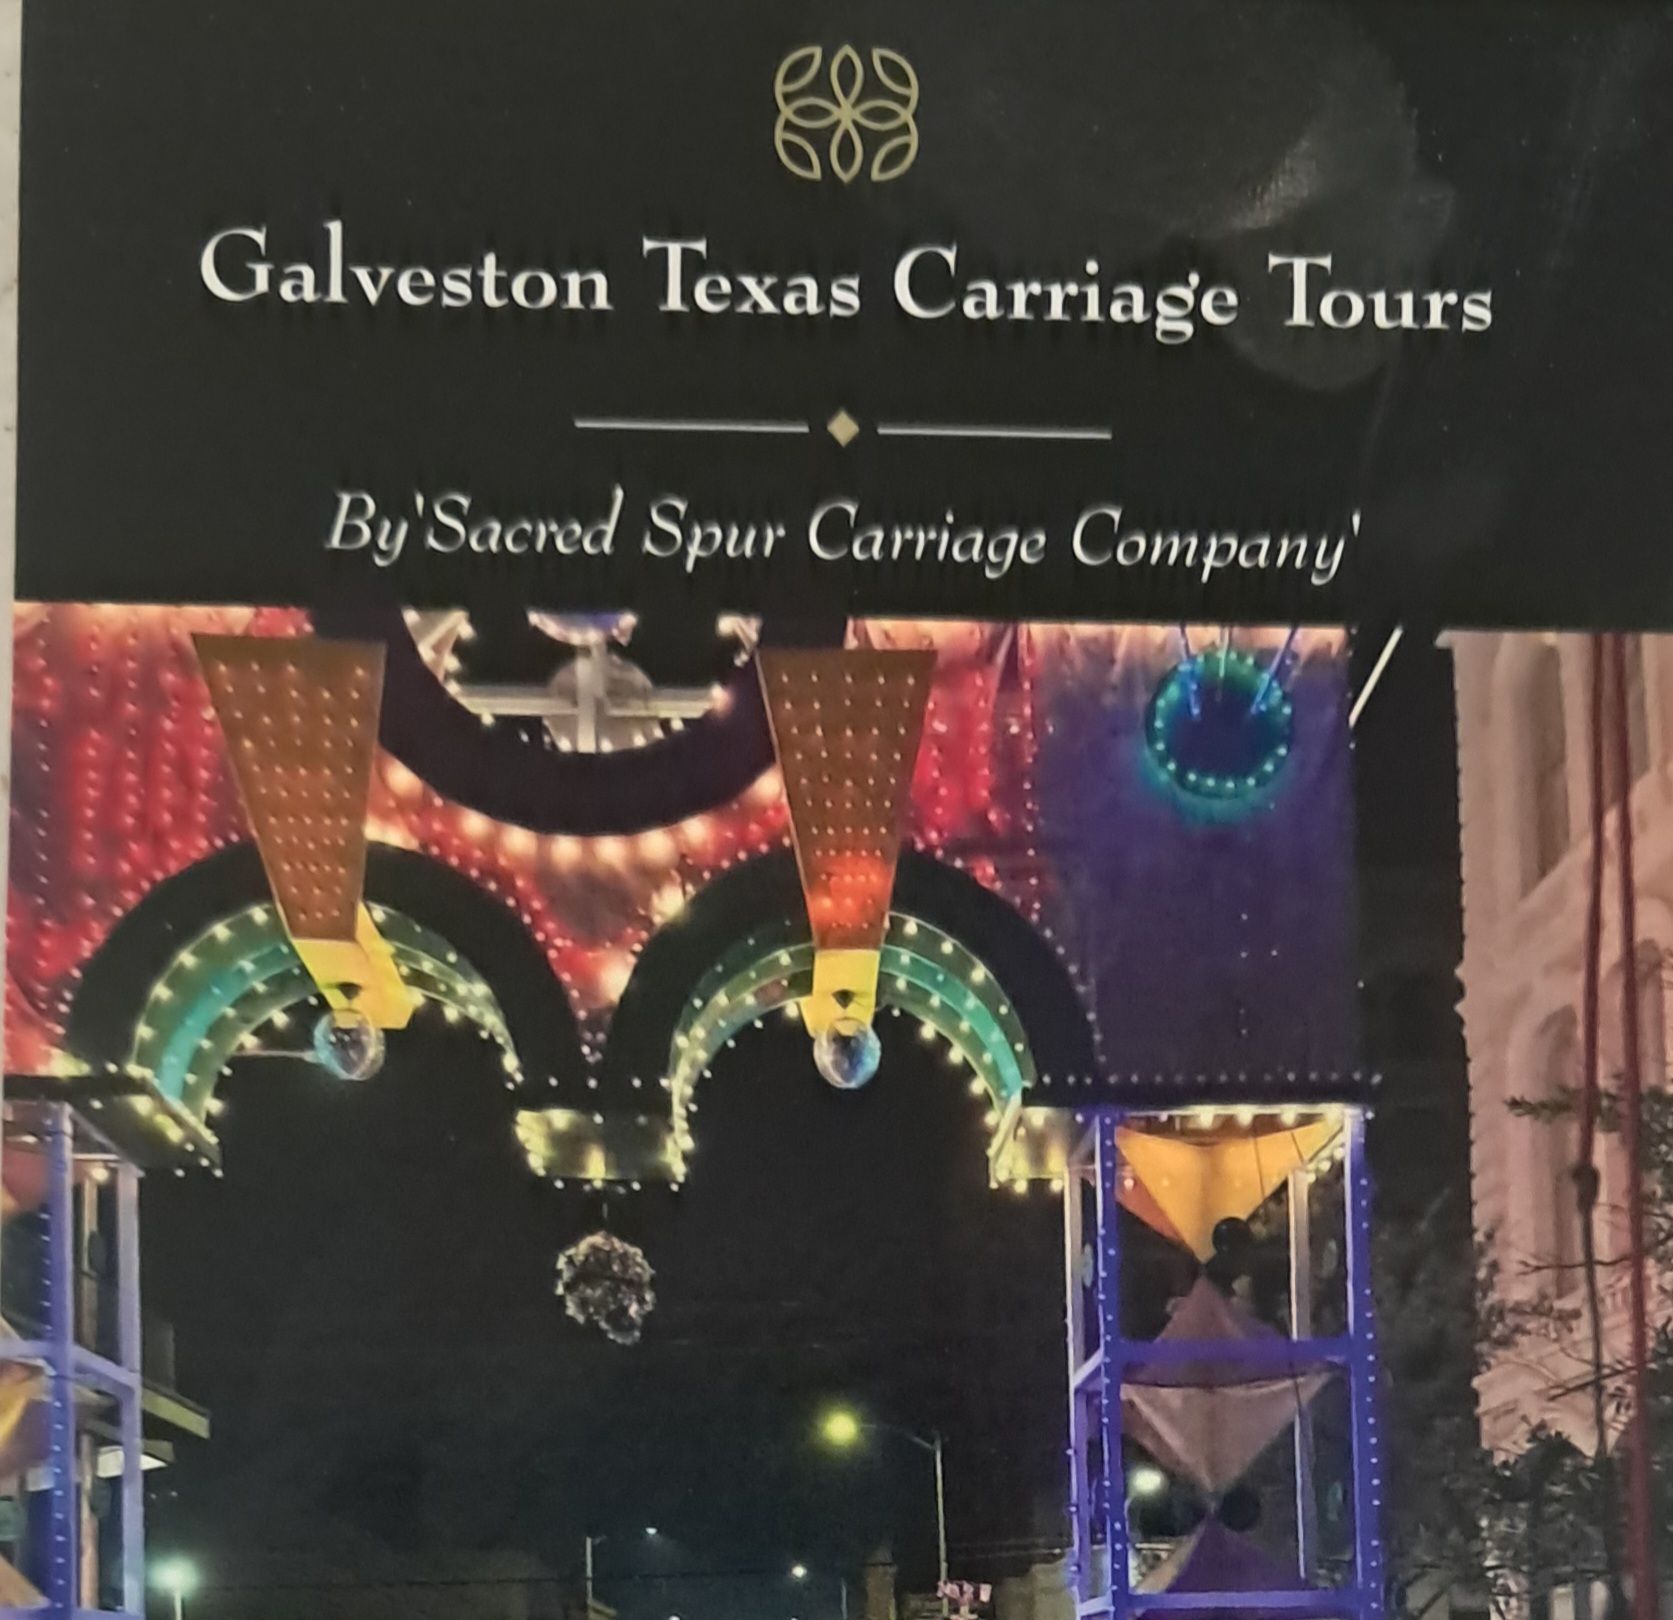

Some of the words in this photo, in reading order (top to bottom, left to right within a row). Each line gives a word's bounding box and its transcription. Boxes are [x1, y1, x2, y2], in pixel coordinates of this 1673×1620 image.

[200, 219, 612, 310] Galveston
[642, 236, 860, 317] Texas
[894, 244, 1238, 344] Carriage
[1268, 253, 1492, 331] Tours
[642, 498, 786, 573] Spur
[808, 502, 1046, 579] Carriage
[1072, 507, 1361, 586] Company'
